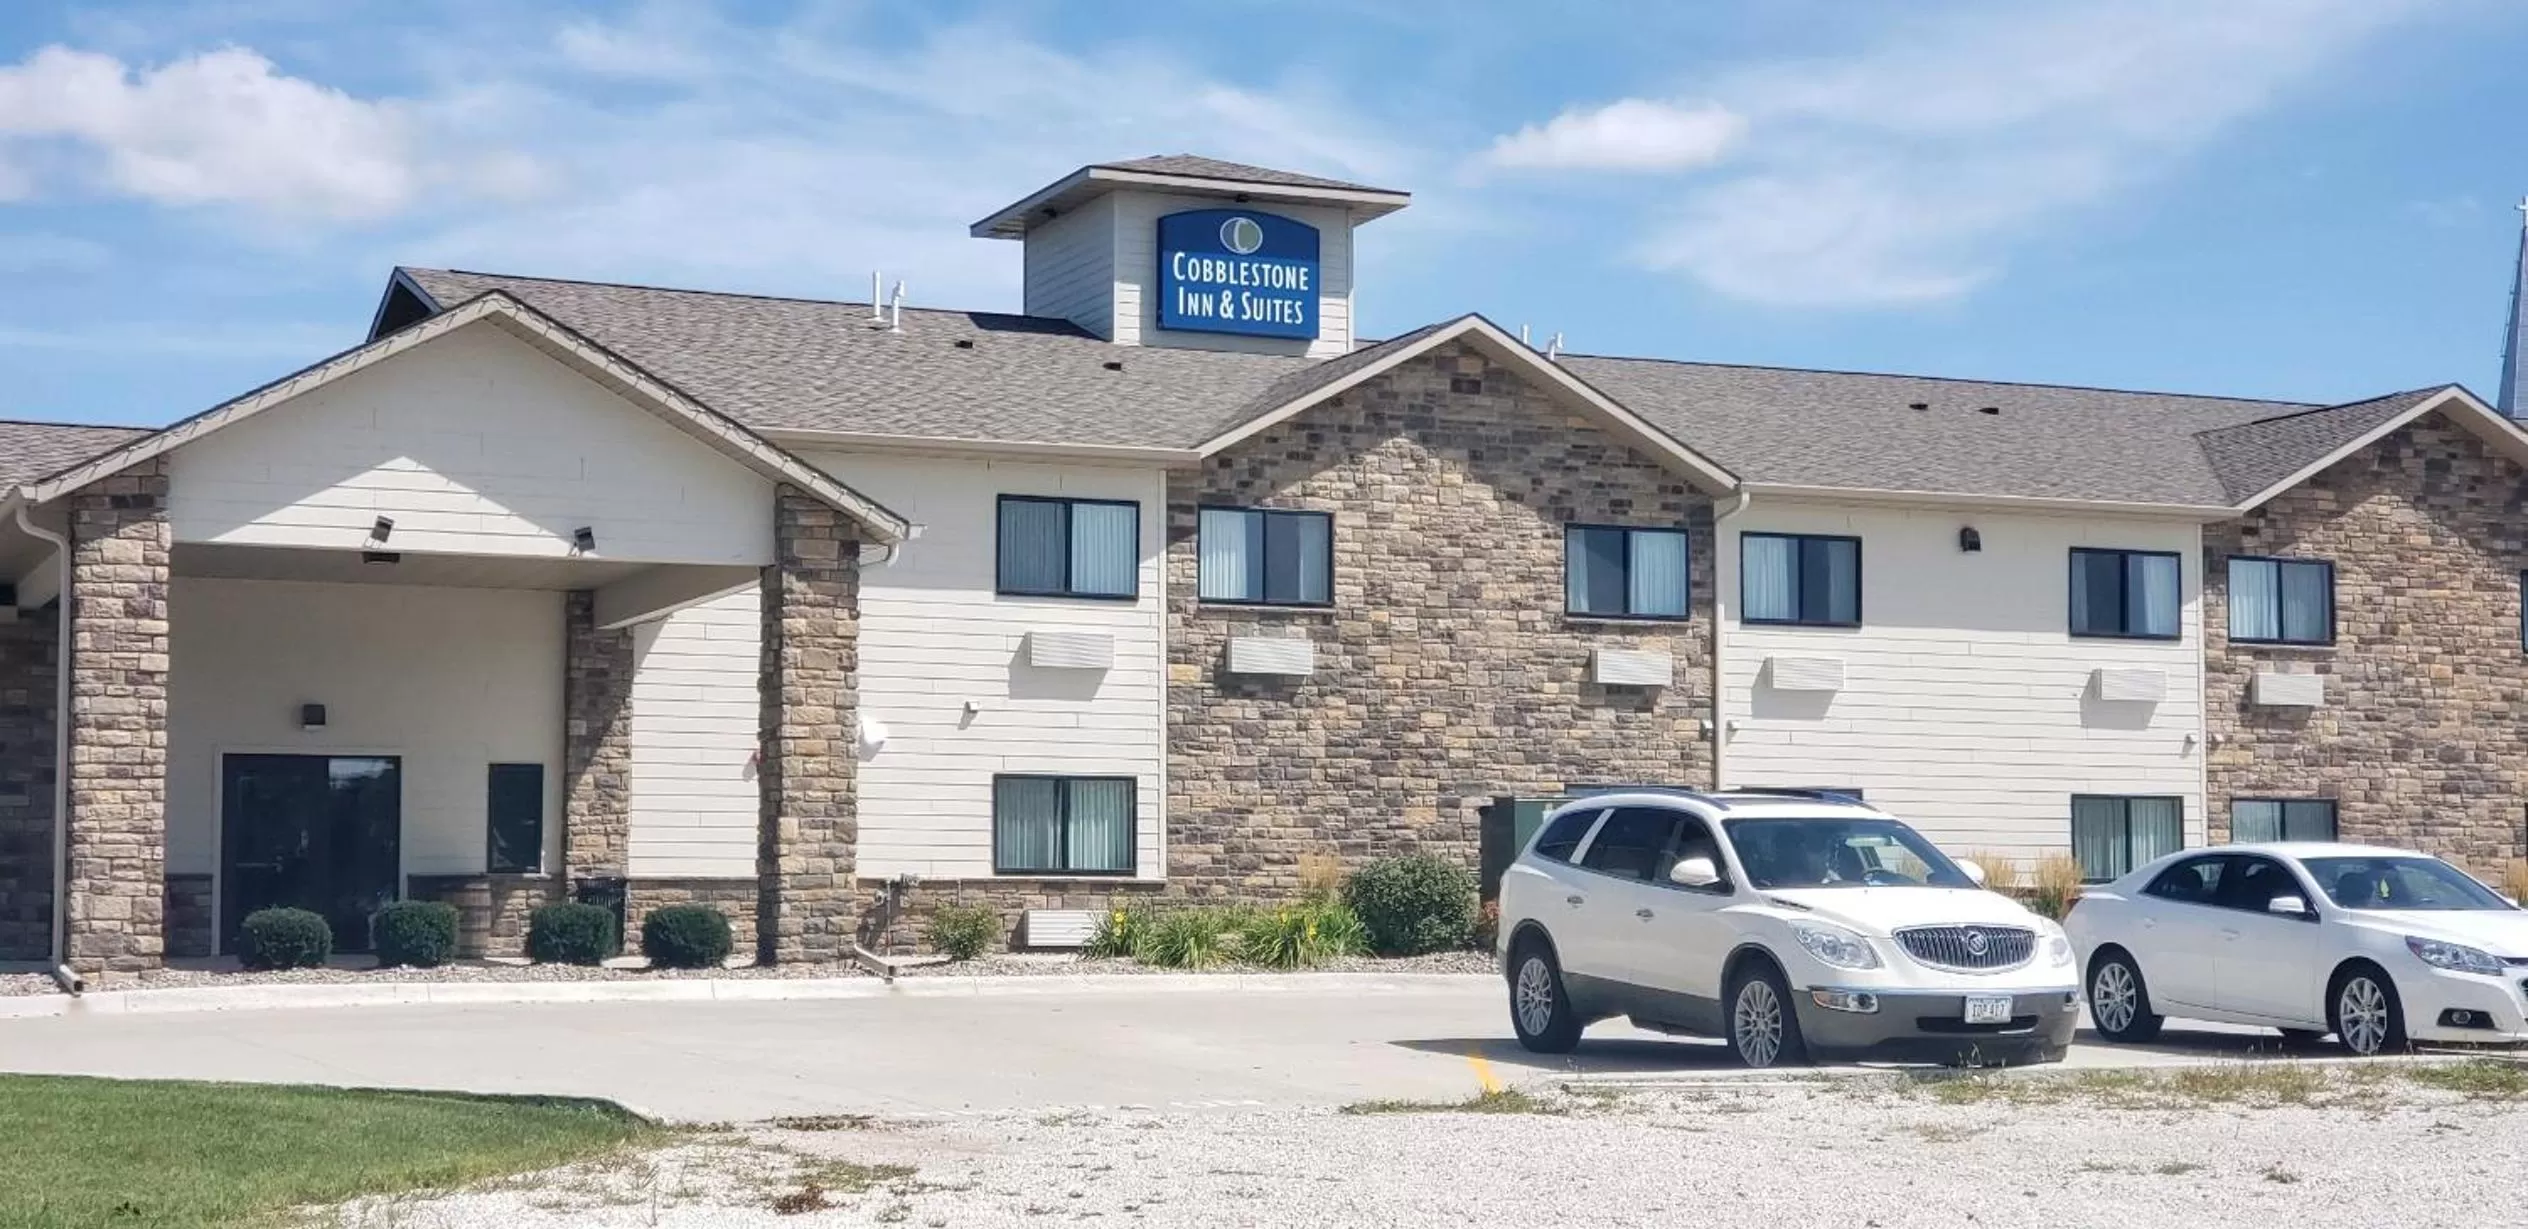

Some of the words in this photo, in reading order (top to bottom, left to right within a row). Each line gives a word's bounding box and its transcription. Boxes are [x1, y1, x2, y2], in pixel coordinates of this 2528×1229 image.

[1173, 251, 1309, 290] COBBLESTONE
[1178, 286, 1213, 317] INN
[1219, 290, 1235, 319] &
[1241, 291, 1304, 325] SUITES
